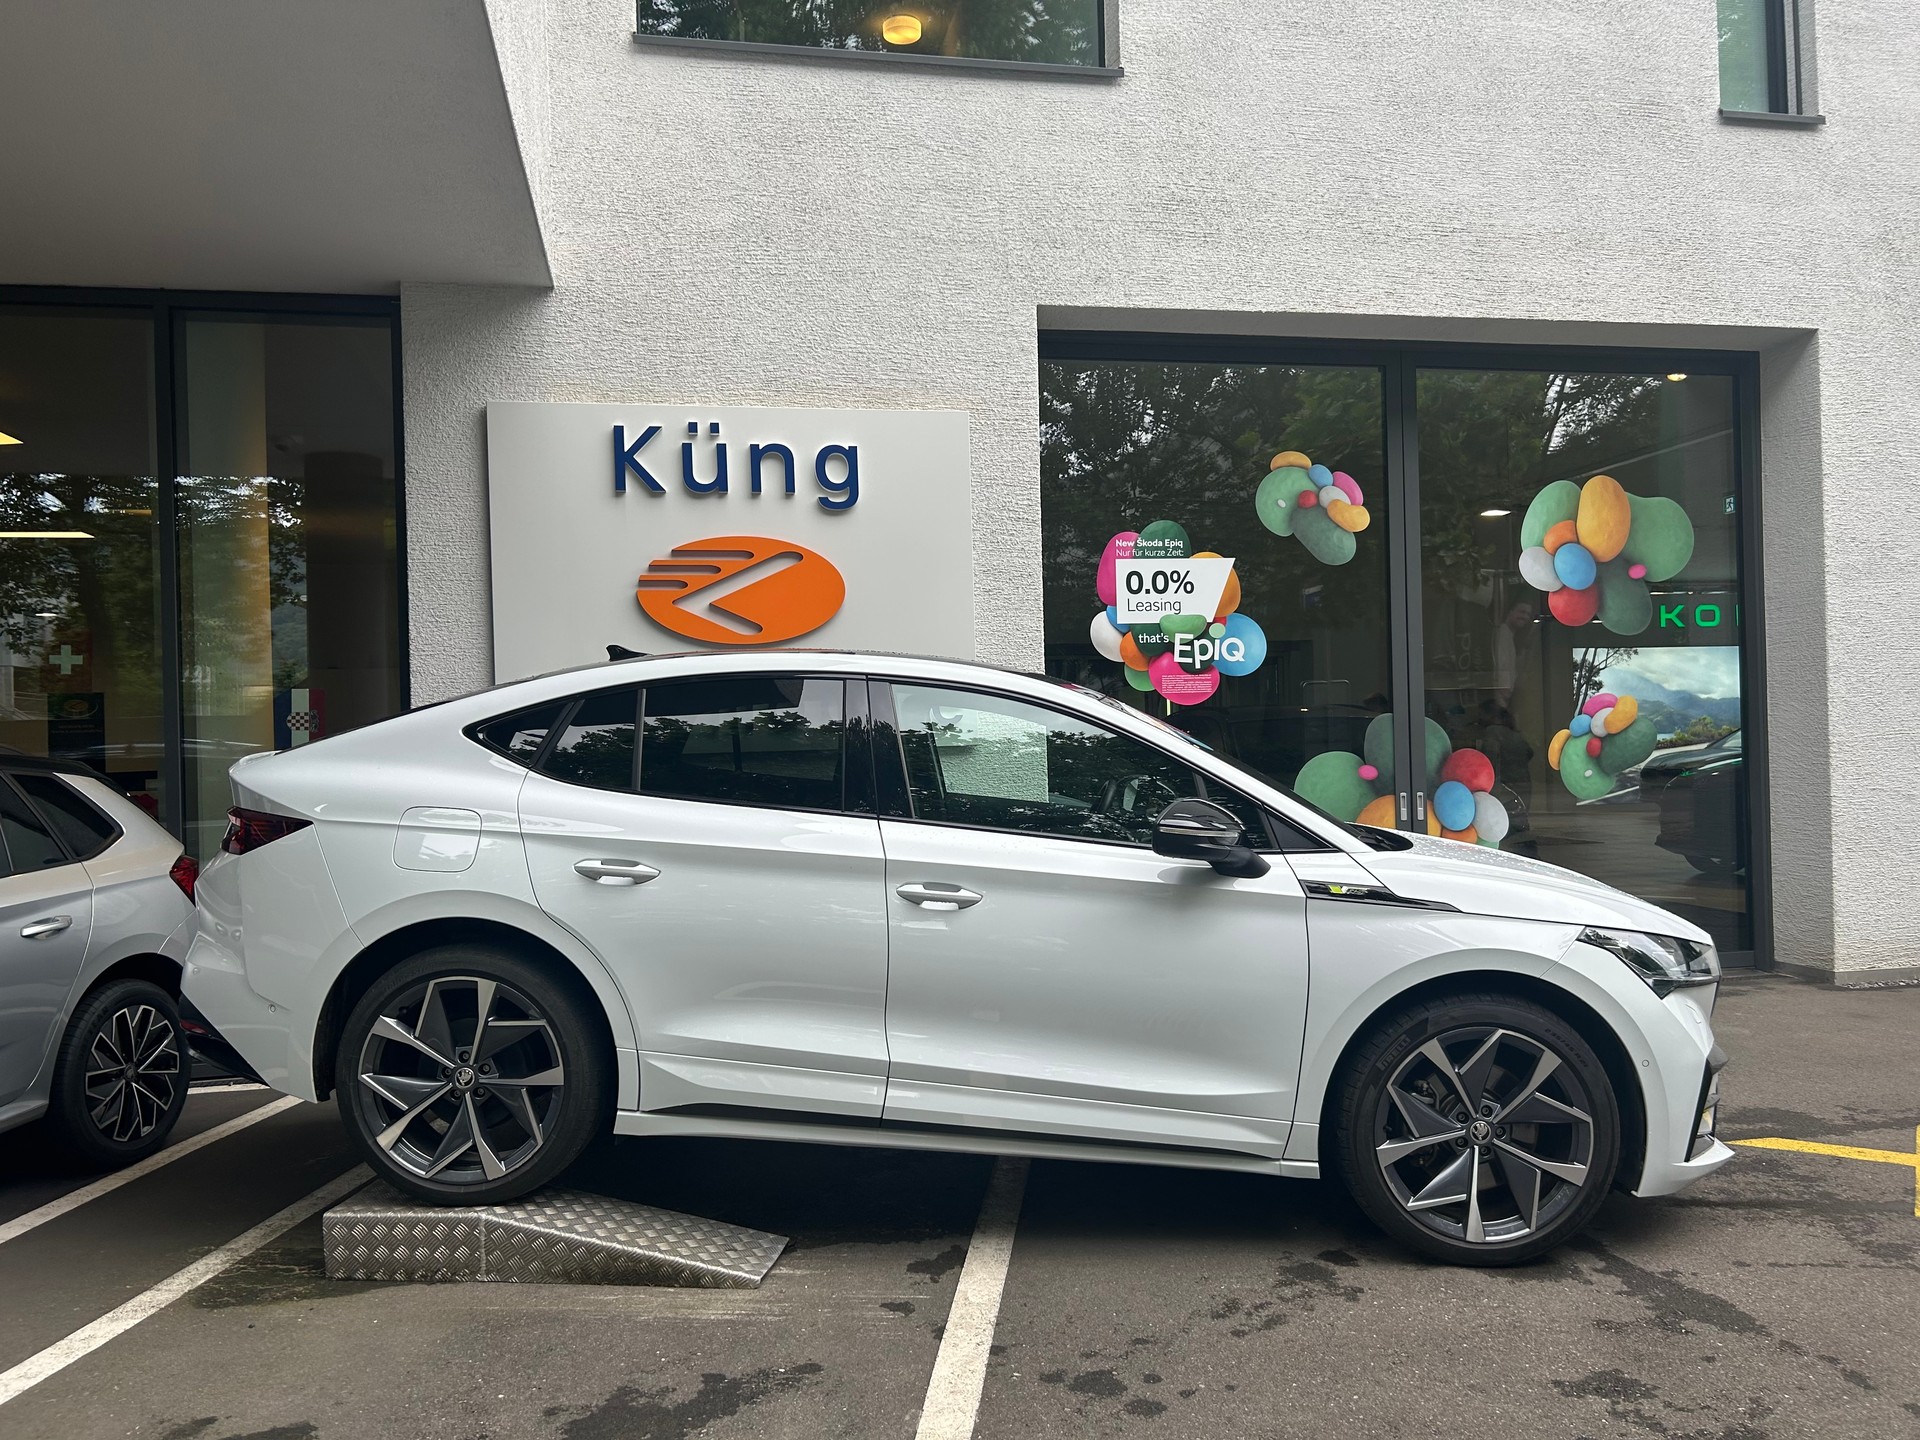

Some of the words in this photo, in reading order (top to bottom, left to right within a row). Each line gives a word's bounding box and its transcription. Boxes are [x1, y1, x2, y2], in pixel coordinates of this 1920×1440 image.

[612, 421, 860, 511] Küng
[1115, 538, 1135, 547] New
[1136, 536, 1163, 547] Škoda
[1164, 538, 1184, 549] Epiq
[1116, 549, 1131, 557] Nur
[1132, 548, 1144, 557] für
[1144, 549, 1166, 557] kurze
[1125, 569, 1195, 595] 0.0%
[1126, 598, 1182, 615] Leasing
[1660, 604, 1739, 628] KO
[1138, 632, 1170, 644] that's
